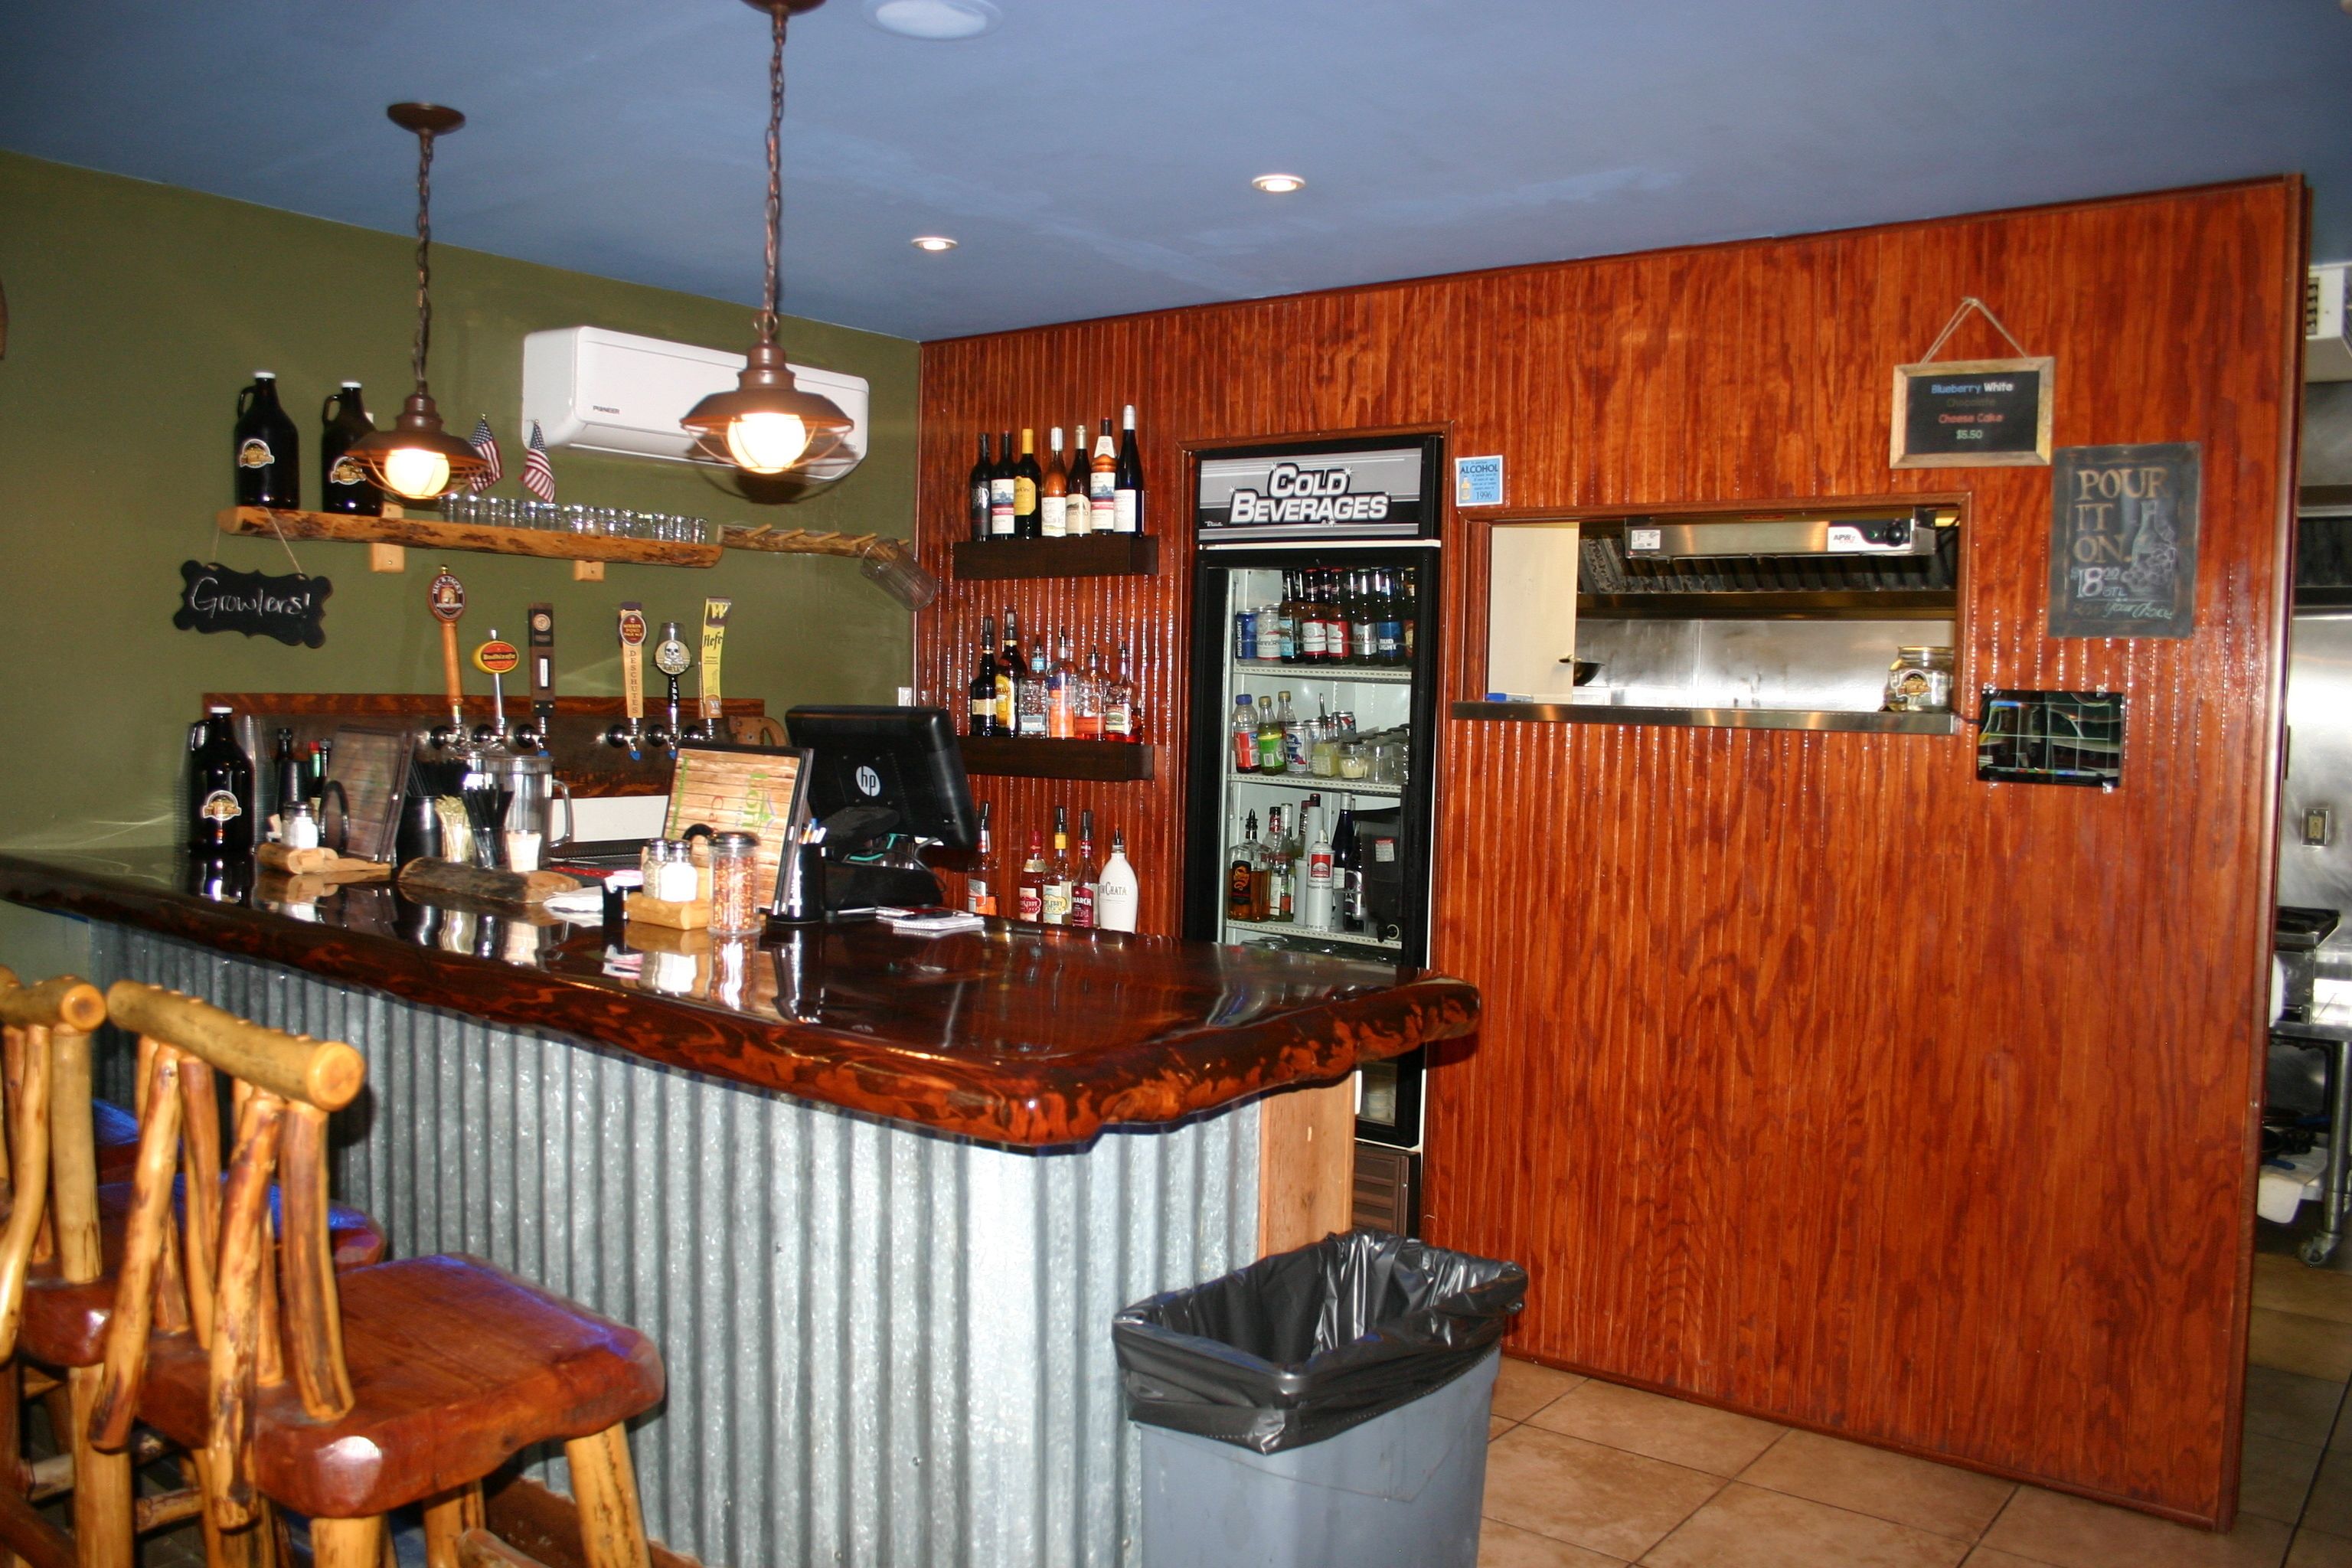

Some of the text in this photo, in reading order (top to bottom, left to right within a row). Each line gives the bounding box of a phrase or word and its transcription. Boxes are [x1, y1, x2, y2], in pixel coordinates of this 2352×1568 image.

[1931, 382, 2014, 394] Blueberry White
[1938, 413, 2004, 423] Cheese Cake
[1955, 430, 1984, 439] $5.50
[1269, 465, 1348, 498] COLD
[1460, 463, 1498, 474] ALCOHOL
[1476, 491, 1492, 500] 1996
[2075, 467, 2170, 501] POUR
[1230, 490, 1389, 524] BEVERAGES
[2076, 502, 2114, 531] IT
[2073, 534, 2132, 563] ON.
[191, 577, 311, 619] Growlers!
[710, 603, 728, 619] W
[704, 632, 723, 650] Hefe
[629, 650, 639, 714] DESCHUTES
[861, 766, 876, 796] hp
